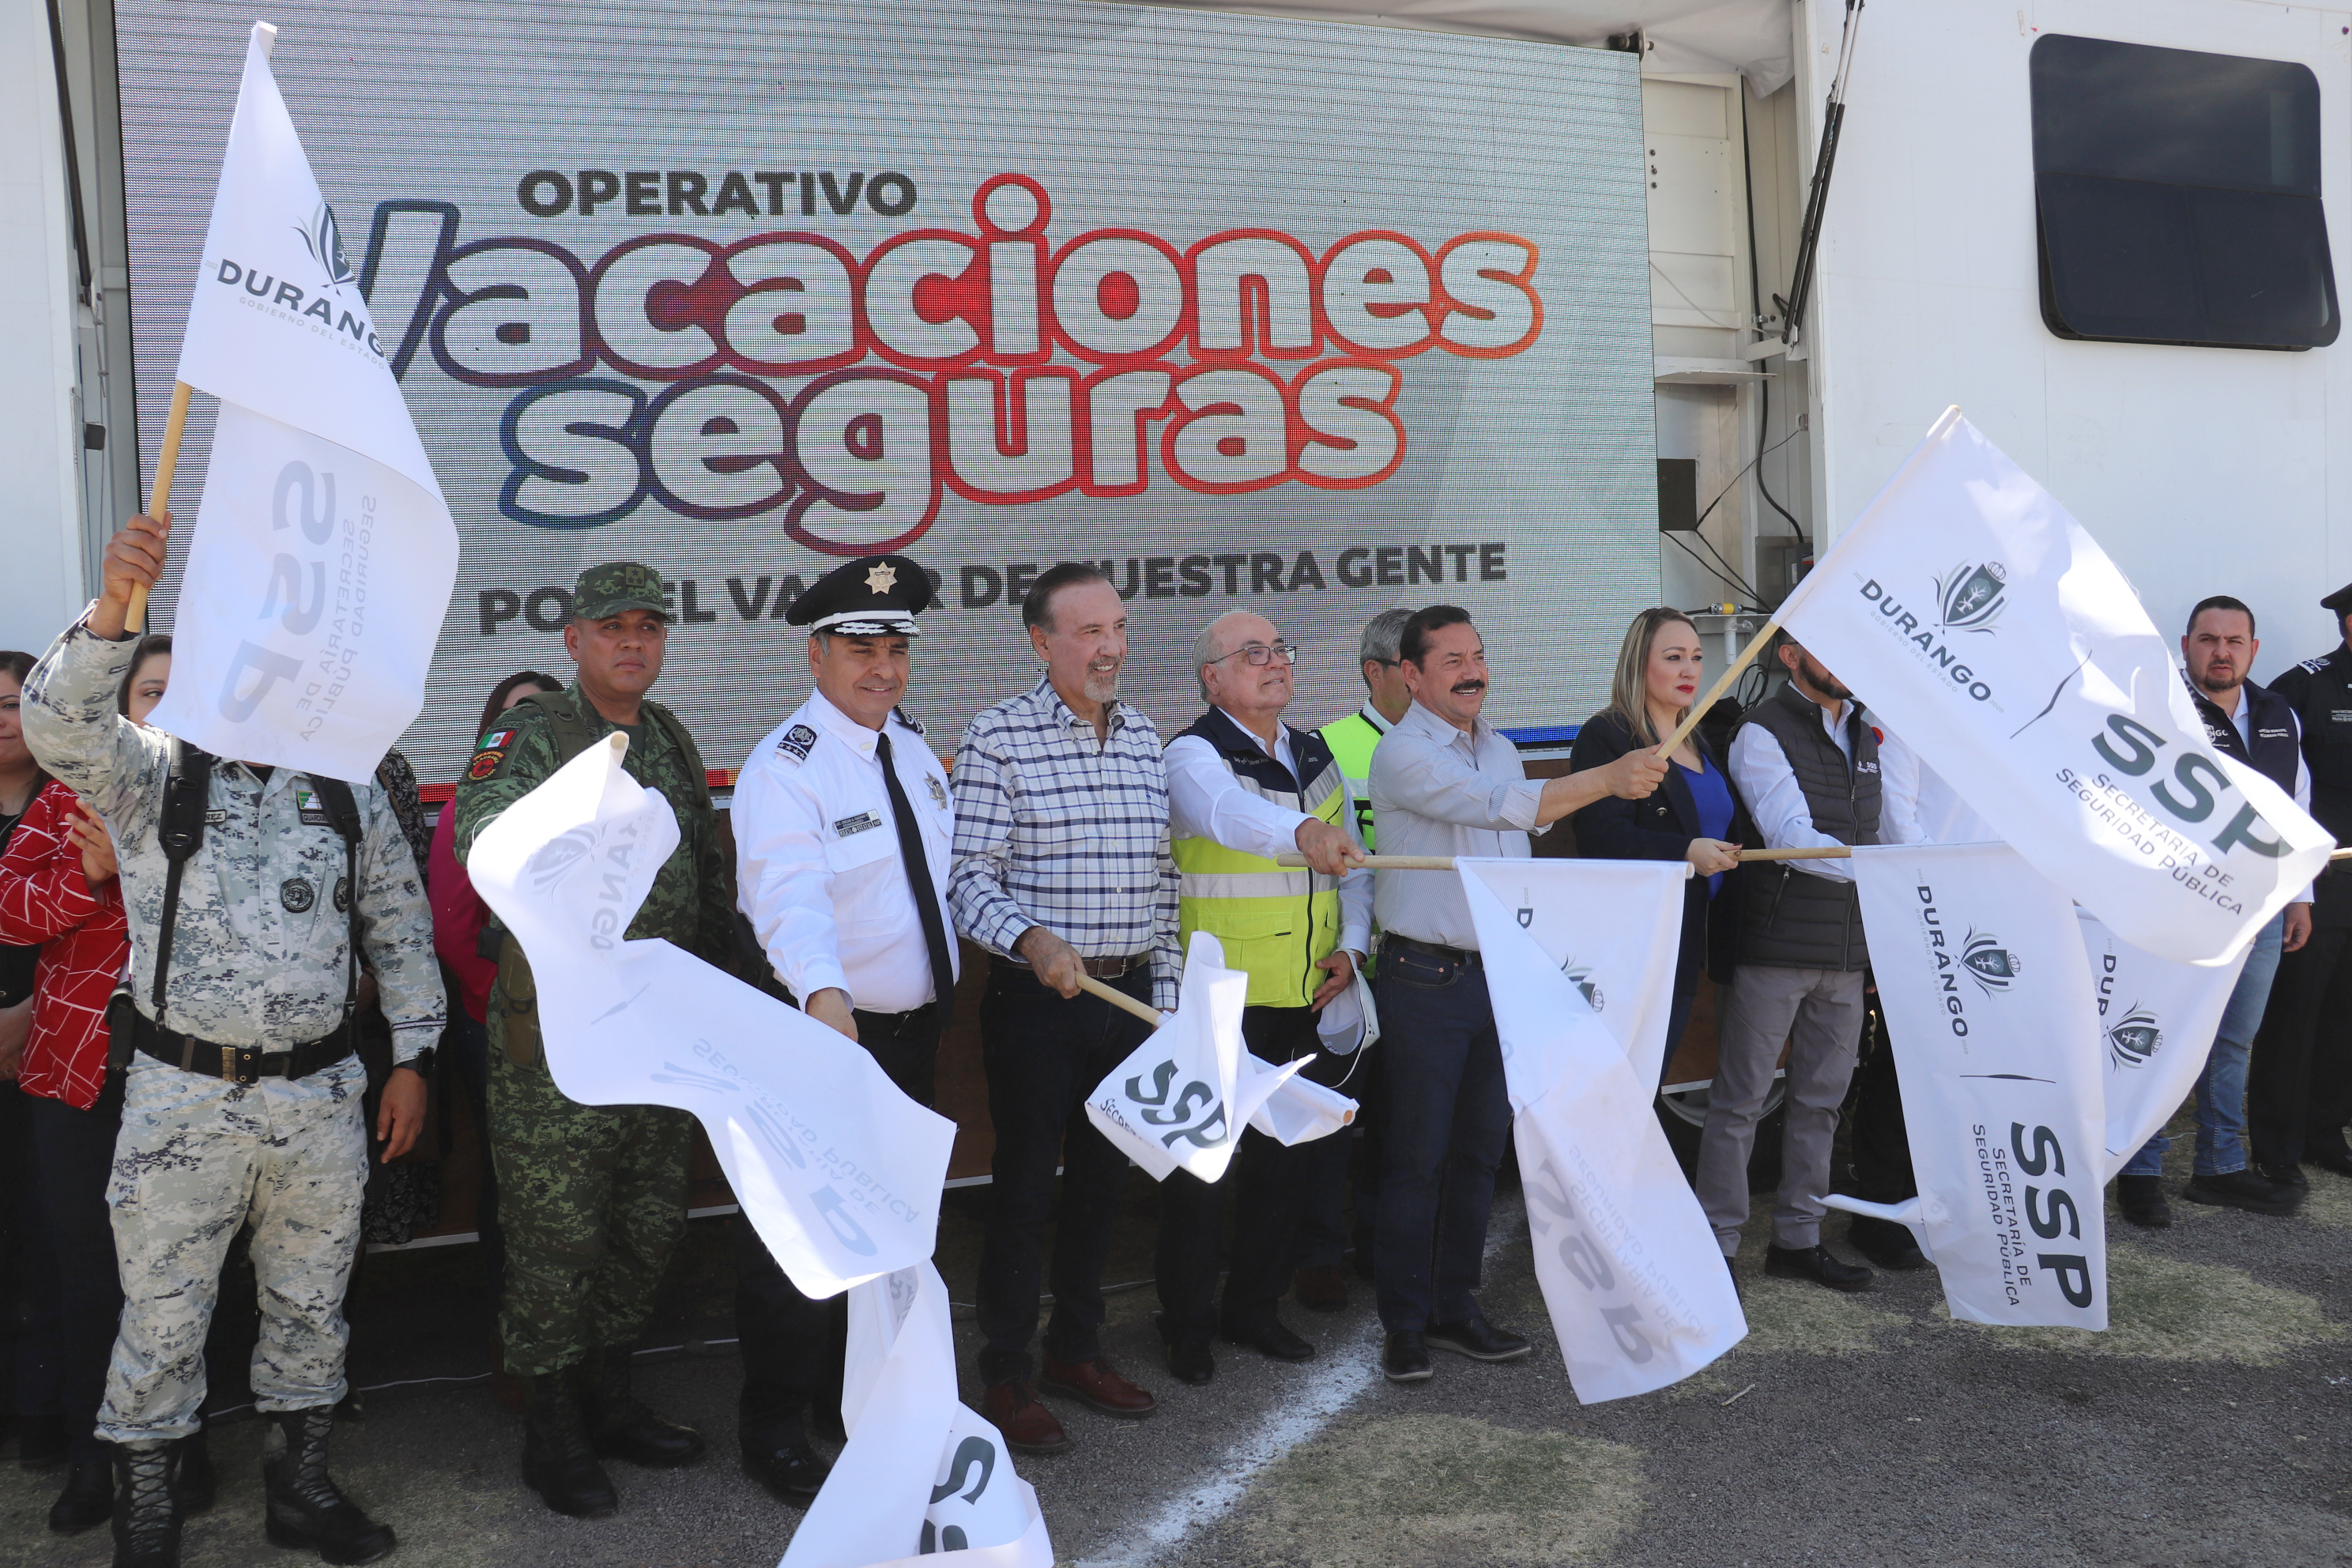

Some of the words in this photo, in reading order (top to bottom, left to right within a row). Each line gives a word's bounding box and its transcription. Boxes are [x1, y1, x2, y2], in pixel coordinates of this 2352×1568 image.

[517, 169, 918, 217] OPERATIVO
[205, 259, 219, 270] 2022
[217, 258, 386, 358] DURANG
[239, 296, 305, 326] GOBIERNO
[311, 325, 334, 341] DEL
[341, 339, 385, 370] ESTADO
[499, 356, 1407, 556] seguras
[477, 585, 575, 634] PO
[959, 564, 1038, 610] DE
[1094, 551, 1326, 601] UESTRA
[1336, 542, 1507, 590] GENTE
[1860, 579, 1992, 702] DURANGO
[1870, 611, 1909, 647] GOBIERNO
[1909, 648, 1924, 663] DEL
[1926, 662, 1958, 692] ESTADO
[2056, 767, 2155, 856] SEGURIDAD
[2158, 855, 2243, 915] PÚBLICA
[2090, 714, 2295, 858] SSP
[2092, 773, 2199, 866] SECRETARÍA
[2203, 864, 2234, 888] DE
[1915, 908, 1932, 956] GOBIERNO
[1933, 979, 1947, 1016] ESTADO
[1917, 885, 1969, 1038] DURANGO
[1125, 1059, 1230, 1148] SSP
[1973, 1123, 2003, 1225] SEGURIDAD
[1996, 1232, 2020, 1306] PÚBLICA
[1992, 1147, 2026, 1257] SECRETARÍA
[2016, 1265, 2032, 1287] DE
[2010, 1121, 2093, 1309] SSP
